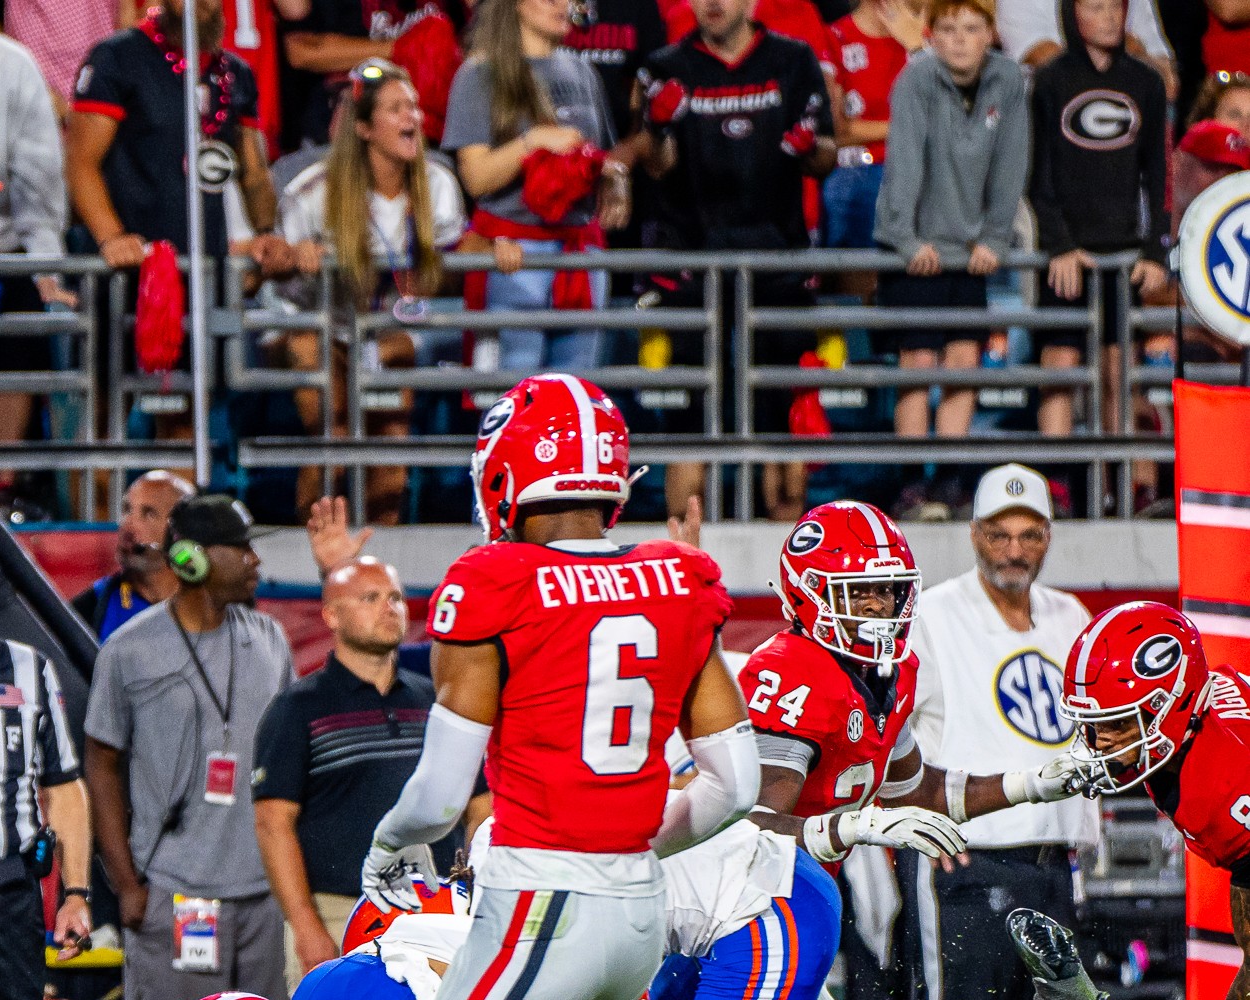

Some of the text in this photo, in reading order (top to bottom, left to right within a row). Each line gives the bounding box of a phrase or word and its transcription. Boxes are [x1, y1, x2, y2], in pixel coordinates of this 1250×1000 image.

[597, 431, 614, 464] 6
[554, 479, 621, 493] GEORGIA
[789, 523, 823, 554] G
[536, 557, 691, 609] EVERETTE
[432, 583, 465, 634] 6
[1134, 636, 1181, 678] G
[581, 613, 658, 776] 6
[747, 669, 812, 729] 24
[6, 726, 22, 752] F
